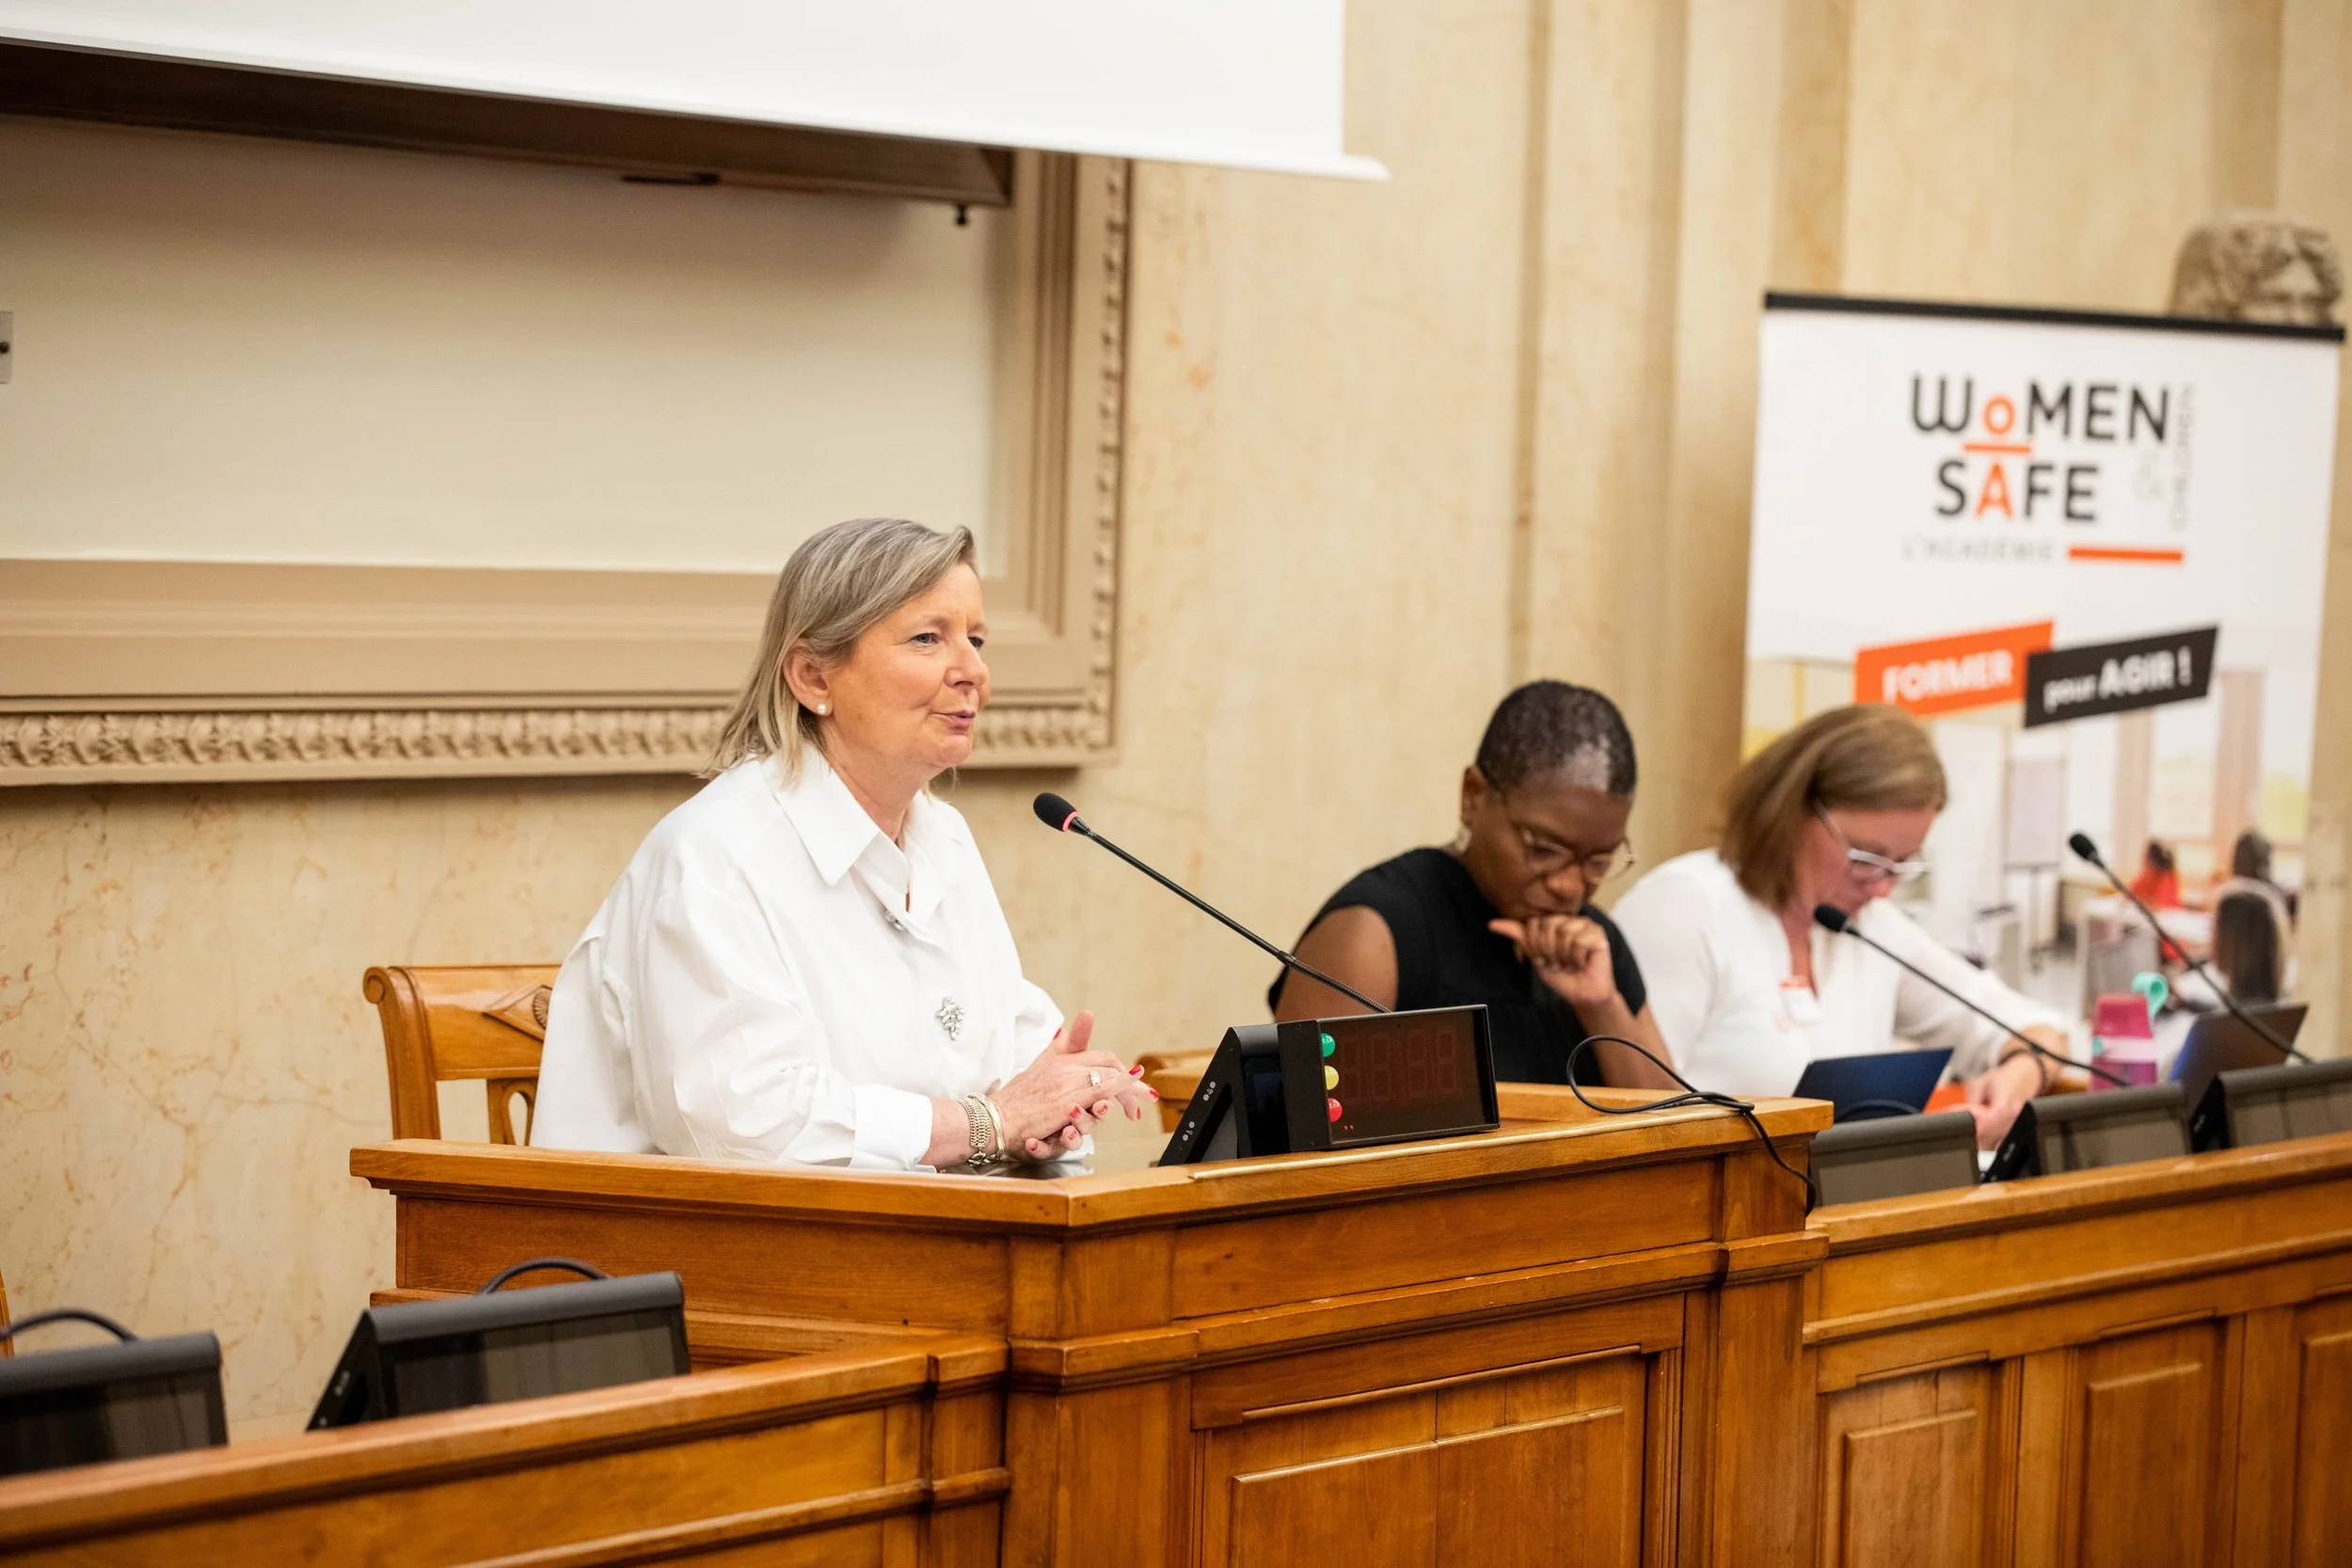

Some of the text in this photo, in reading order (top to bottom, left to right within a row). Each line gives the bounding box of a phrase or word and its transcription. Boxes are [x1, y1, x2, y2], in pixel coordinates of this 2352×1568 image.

[1936, 460, 2099, 522] SAFE
[1883, 649, 2013, 704] FORMER
[2043, 674, 2097, 715] pour
